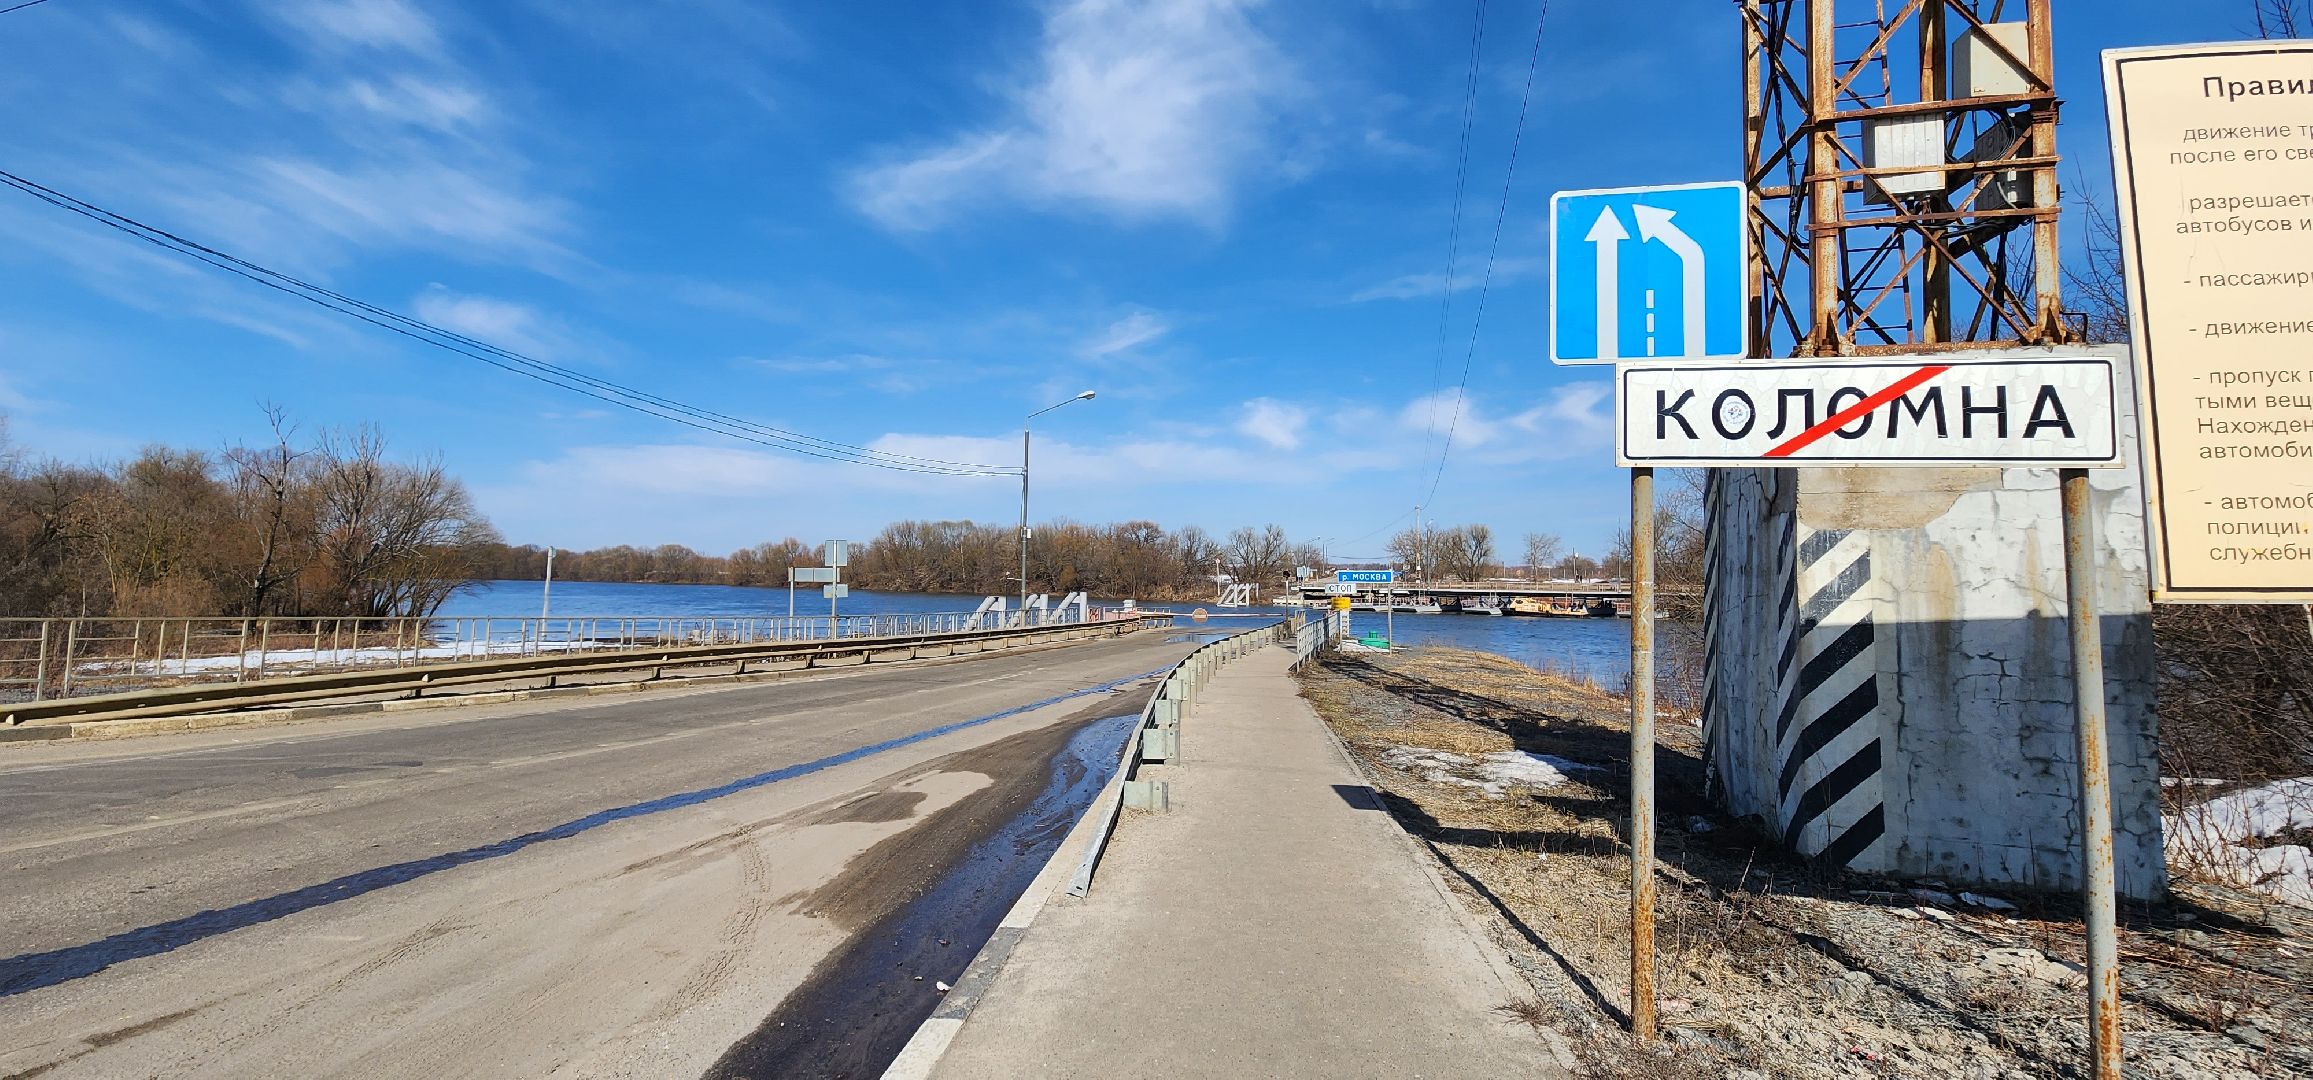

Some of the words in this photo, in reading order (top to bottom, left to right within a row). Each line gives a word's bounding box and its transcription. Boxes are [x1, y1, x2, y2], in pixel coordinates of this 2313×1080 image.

[2183, 125, 2291, 144] движение
[2297, 125, 2313, 140] т
[2170, 150, 2236, 165] после
[2243, 148, 2278, 162] его
[2189, 194, 2313, 214] разрешает
[2176, 215, 2293, 236] автобусов
[2199, 271, 2313, 288] пассажир
[2209, 370, 2302, 388] пропуск
[2194, 396, 2257, 409] тыми
[1656, 384, 2077, 441] КОЛОМНА
[2209, 542, 2311, 565] служебн
[1352, 573, 1387, 581] МОСКВА
[1328, 584, 1352, 593] СТОП
